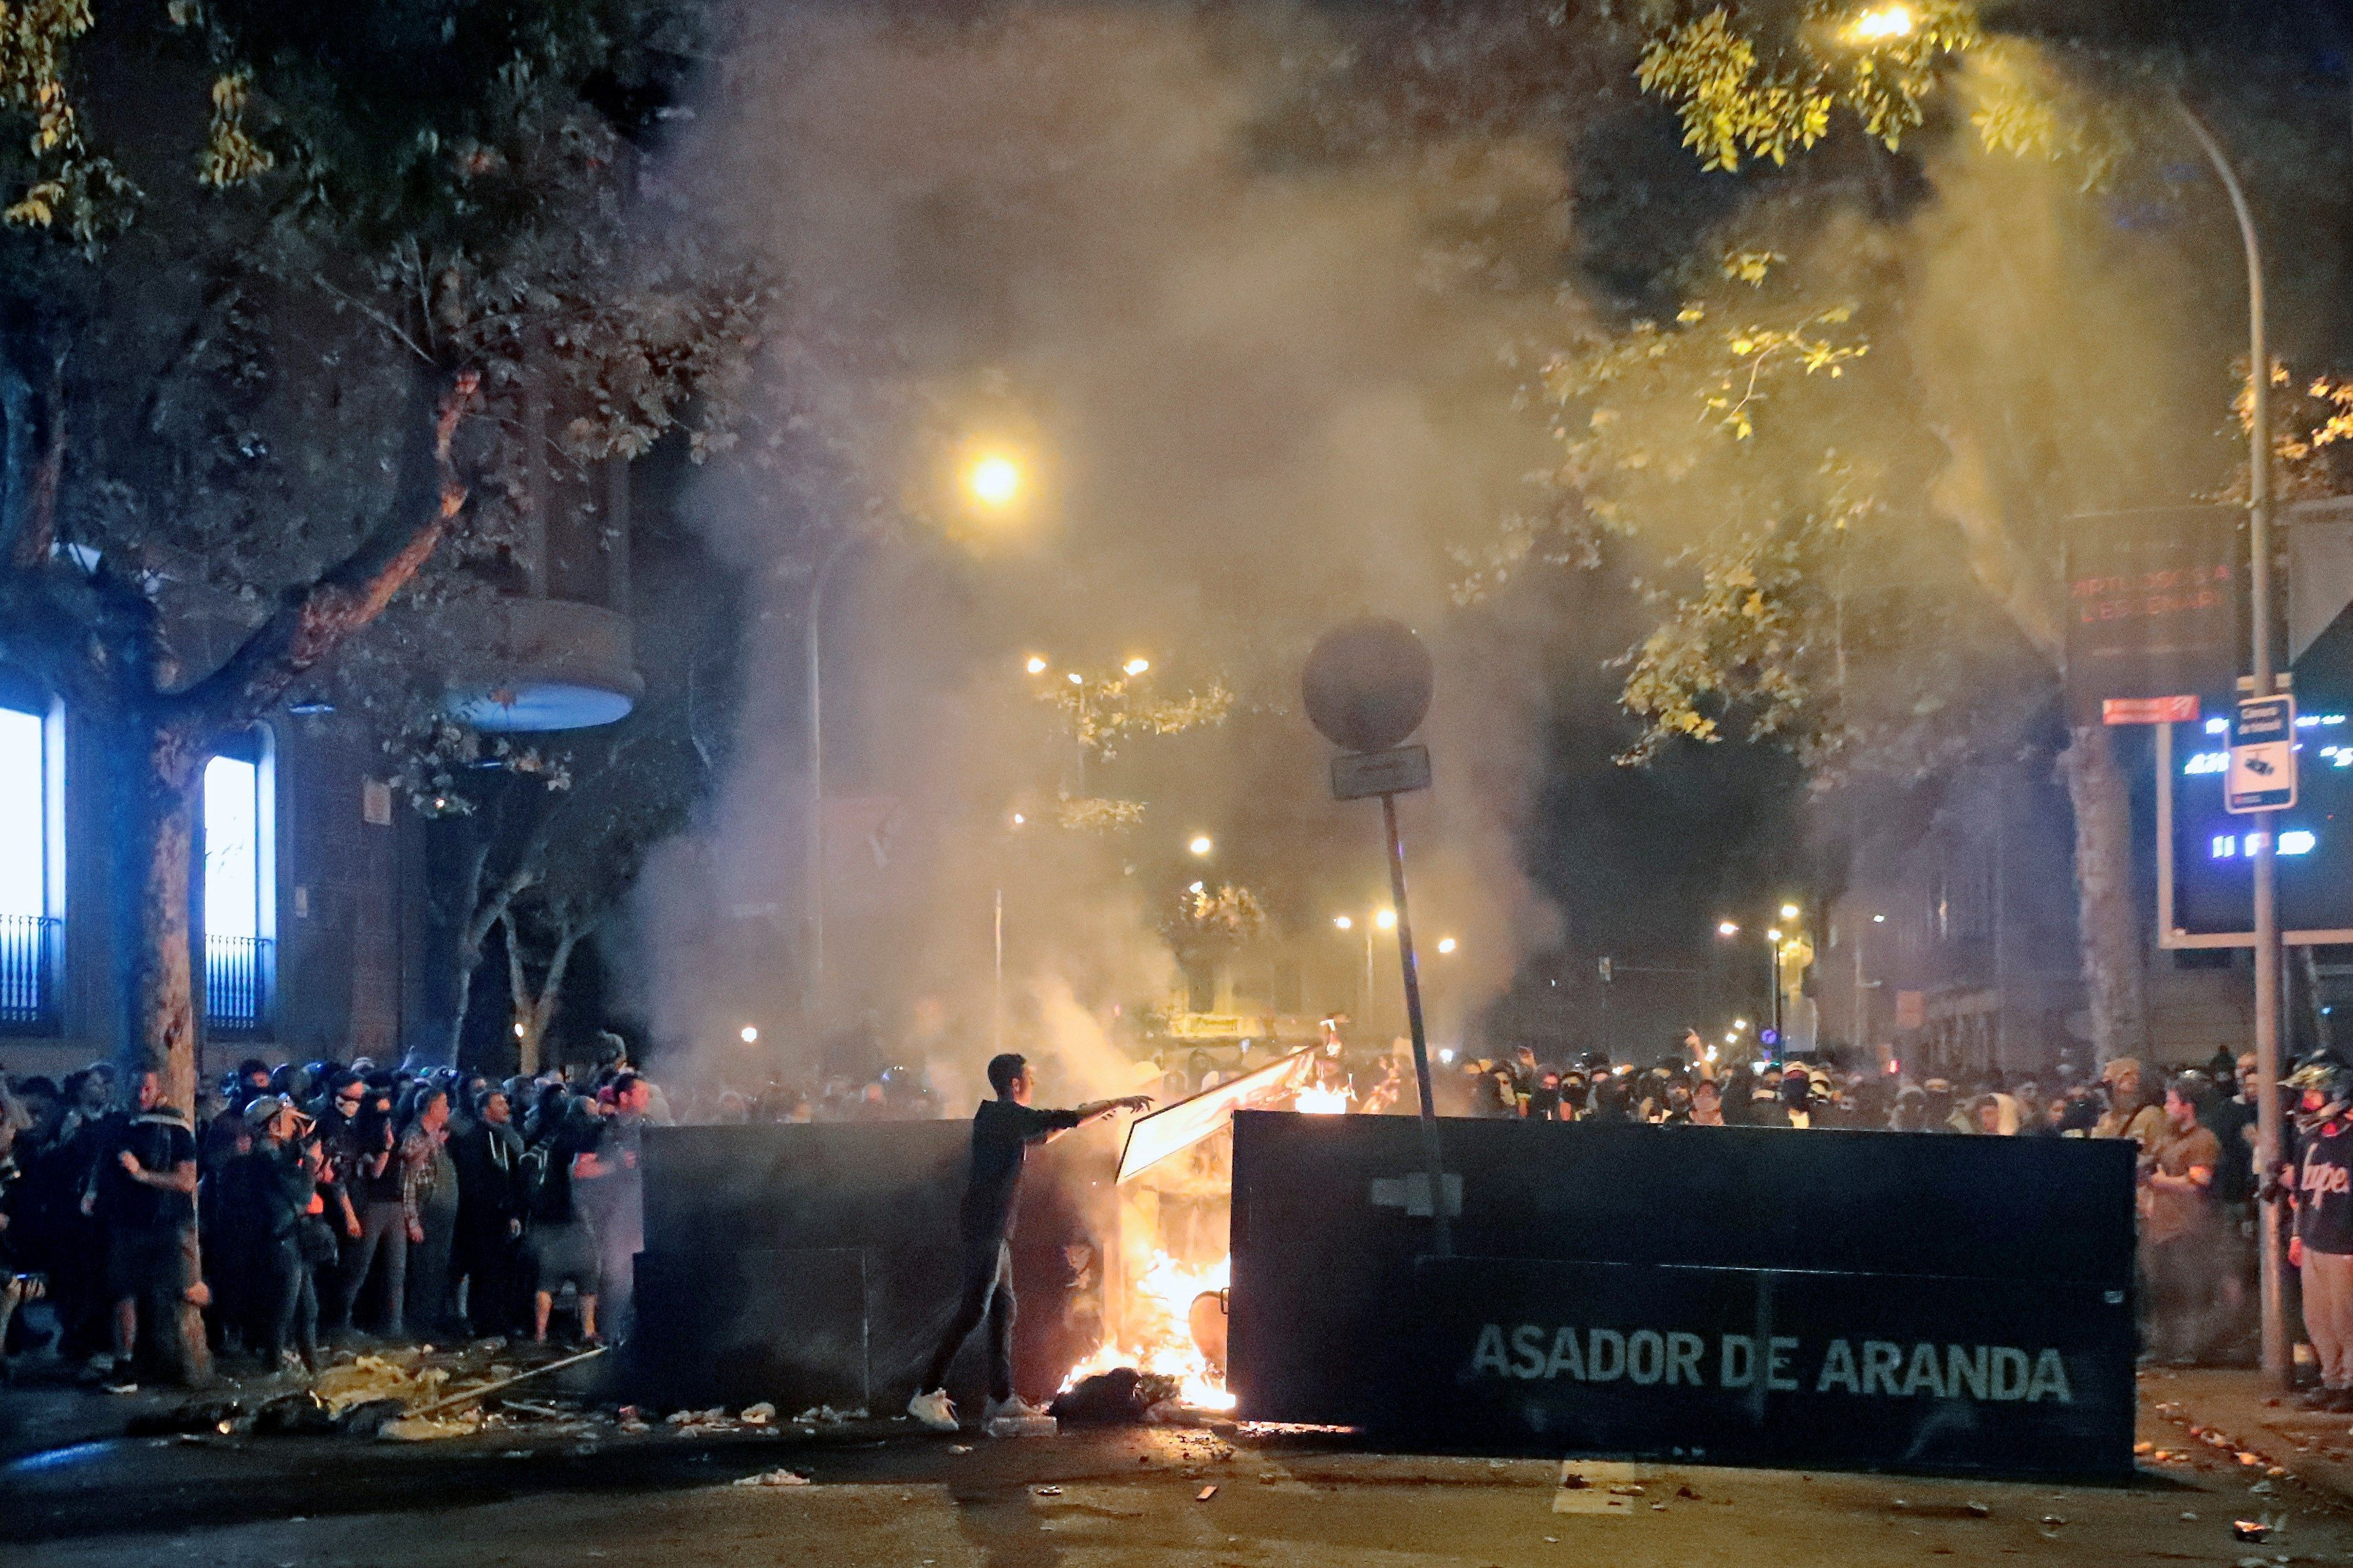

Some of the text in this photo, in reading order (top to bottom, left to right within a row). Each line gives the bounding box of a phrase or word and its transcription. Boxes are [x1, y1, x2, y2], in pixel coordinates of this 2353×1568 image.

[1472, 1323, 2073, 1404] ASADOR DE ARANDA
